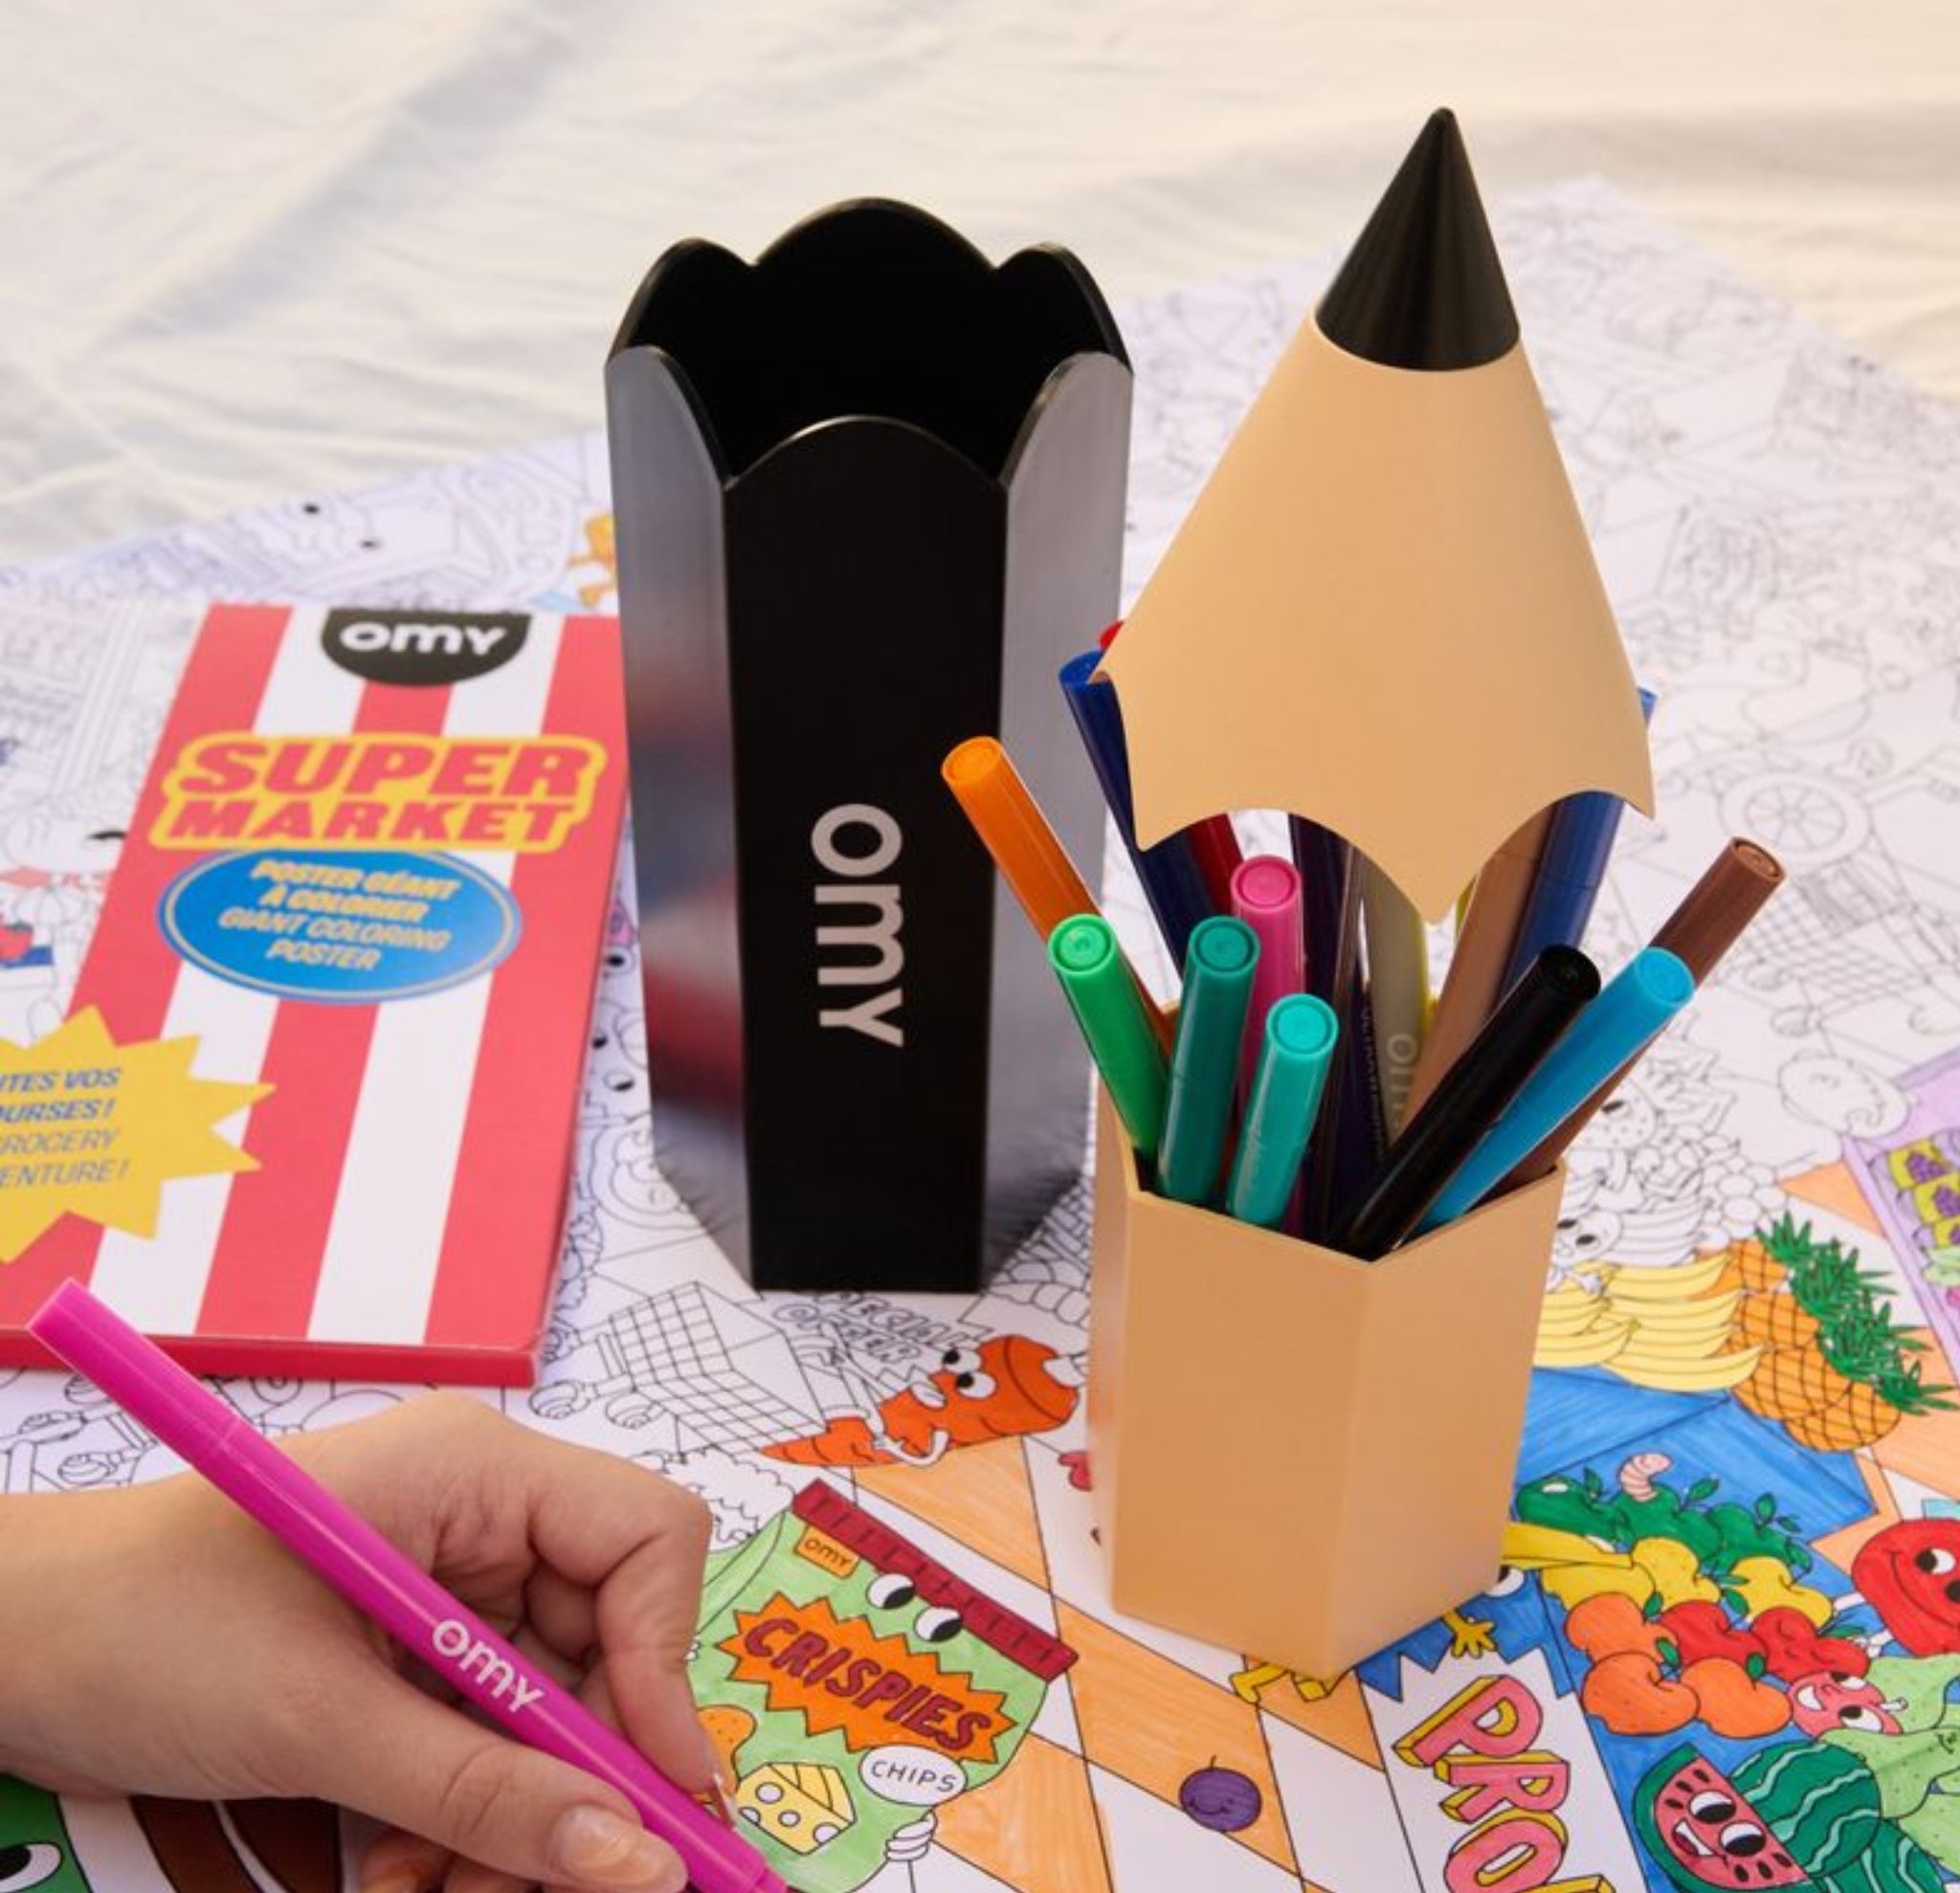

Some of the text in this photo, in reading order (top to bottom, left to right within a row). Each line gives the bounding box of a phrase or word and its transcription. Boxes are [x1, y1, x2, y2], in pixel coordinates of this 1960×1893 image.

[178, 741, 591, 795] SUPER
[166, 798, 573, 842] MARKET
[250, 858, 364, 889] POSTER
[218, 906, 452, 951] GIANT COLORING
[264, 938, 382, 970] POSTER
[64, 1066, 123, 1090] VOS
[745, 1618, 992, 1750] CRISPIES
[870, 1760, 958, 1793] CHIPS
[1392, 1675, 1616, 1893] PRO
